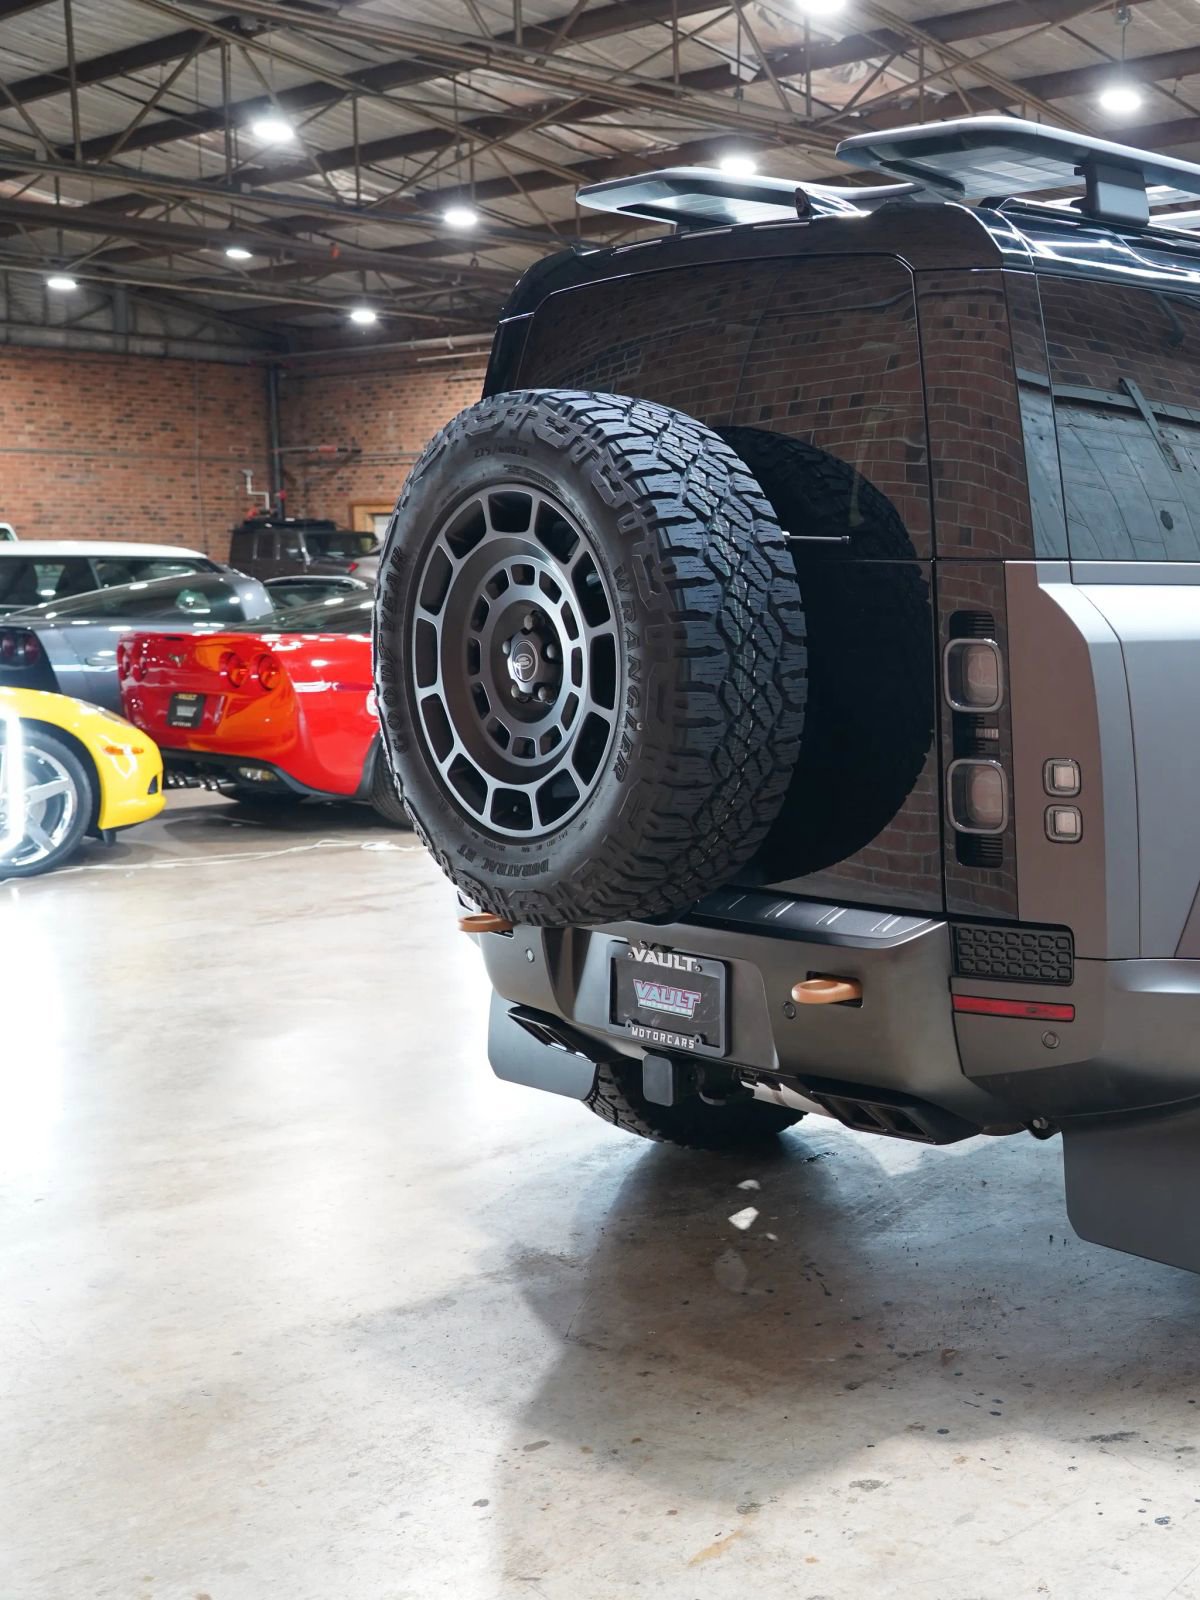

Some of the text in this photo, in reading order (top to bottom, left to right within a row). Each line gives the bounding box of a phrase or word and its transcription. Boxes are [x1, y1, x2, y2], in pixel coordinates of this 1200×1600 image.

[613, 564, 641, 783] WRANGLER
[632, 947, 697, 972] VAULT
[633, 979, 701, 1010] VAULT
[632, 1026, 695, 1049] MOTORCARS
